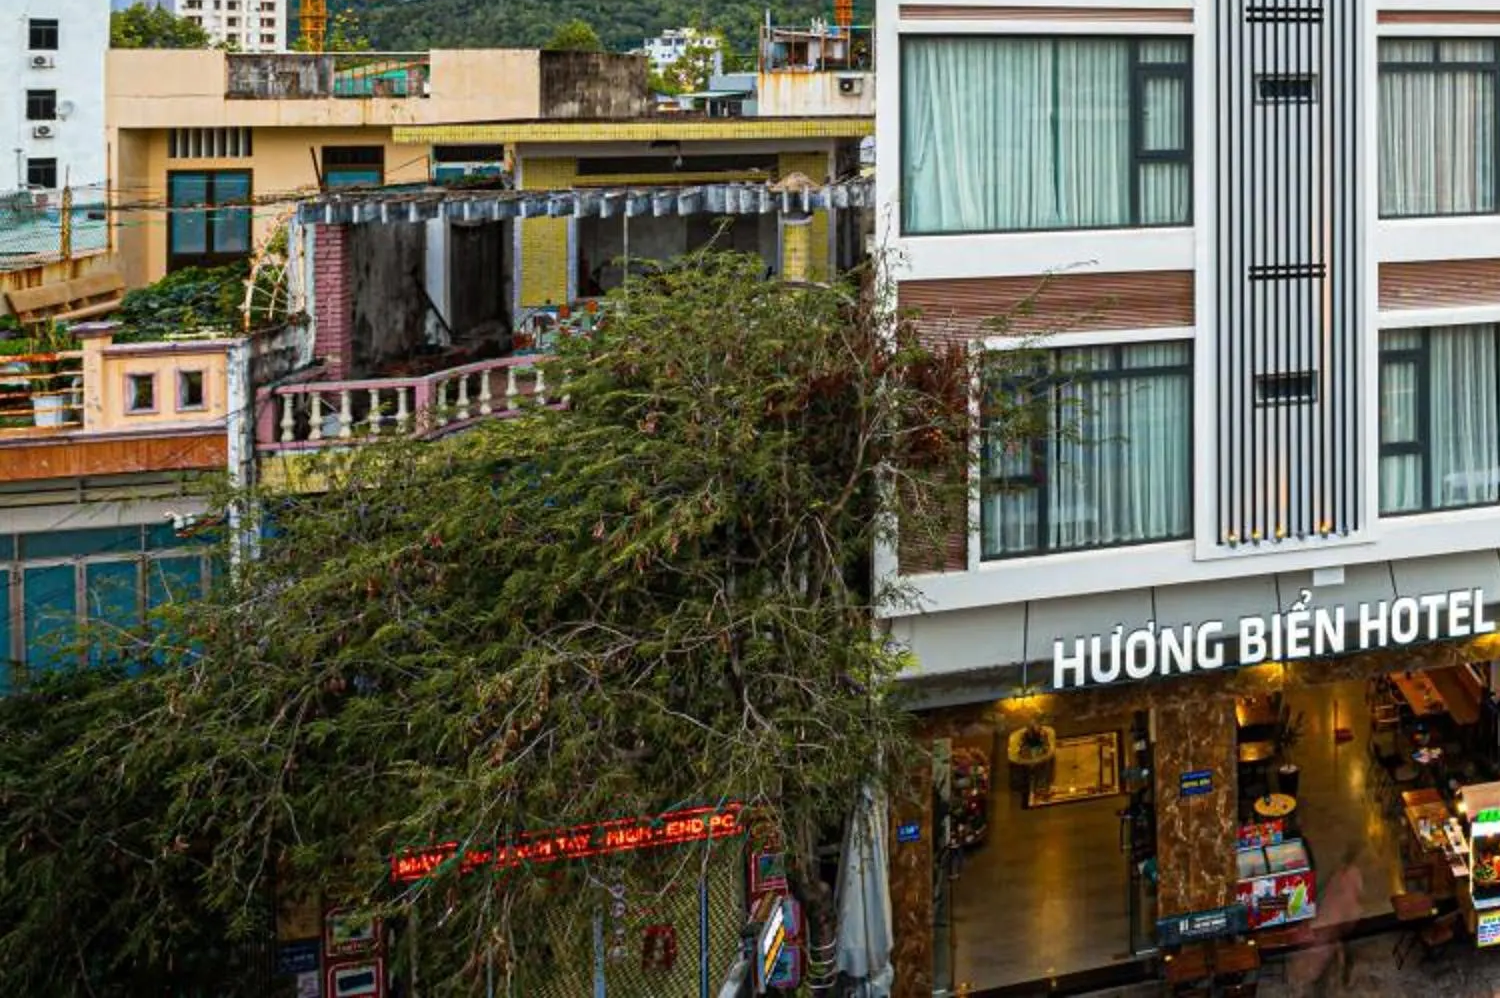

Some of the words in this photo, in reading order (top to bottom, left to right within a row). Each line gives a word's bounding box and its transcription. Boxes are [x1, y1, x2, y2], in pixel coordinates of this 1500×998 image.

[1053, 620, 1224, 690] HƯƠNG
[1239, 589, 1346, 665] BIỂN
[1358, 588, 1497, 650] HOTEL
[666, 818, 705, 837] END
[709, 814, 735, 829] PC
